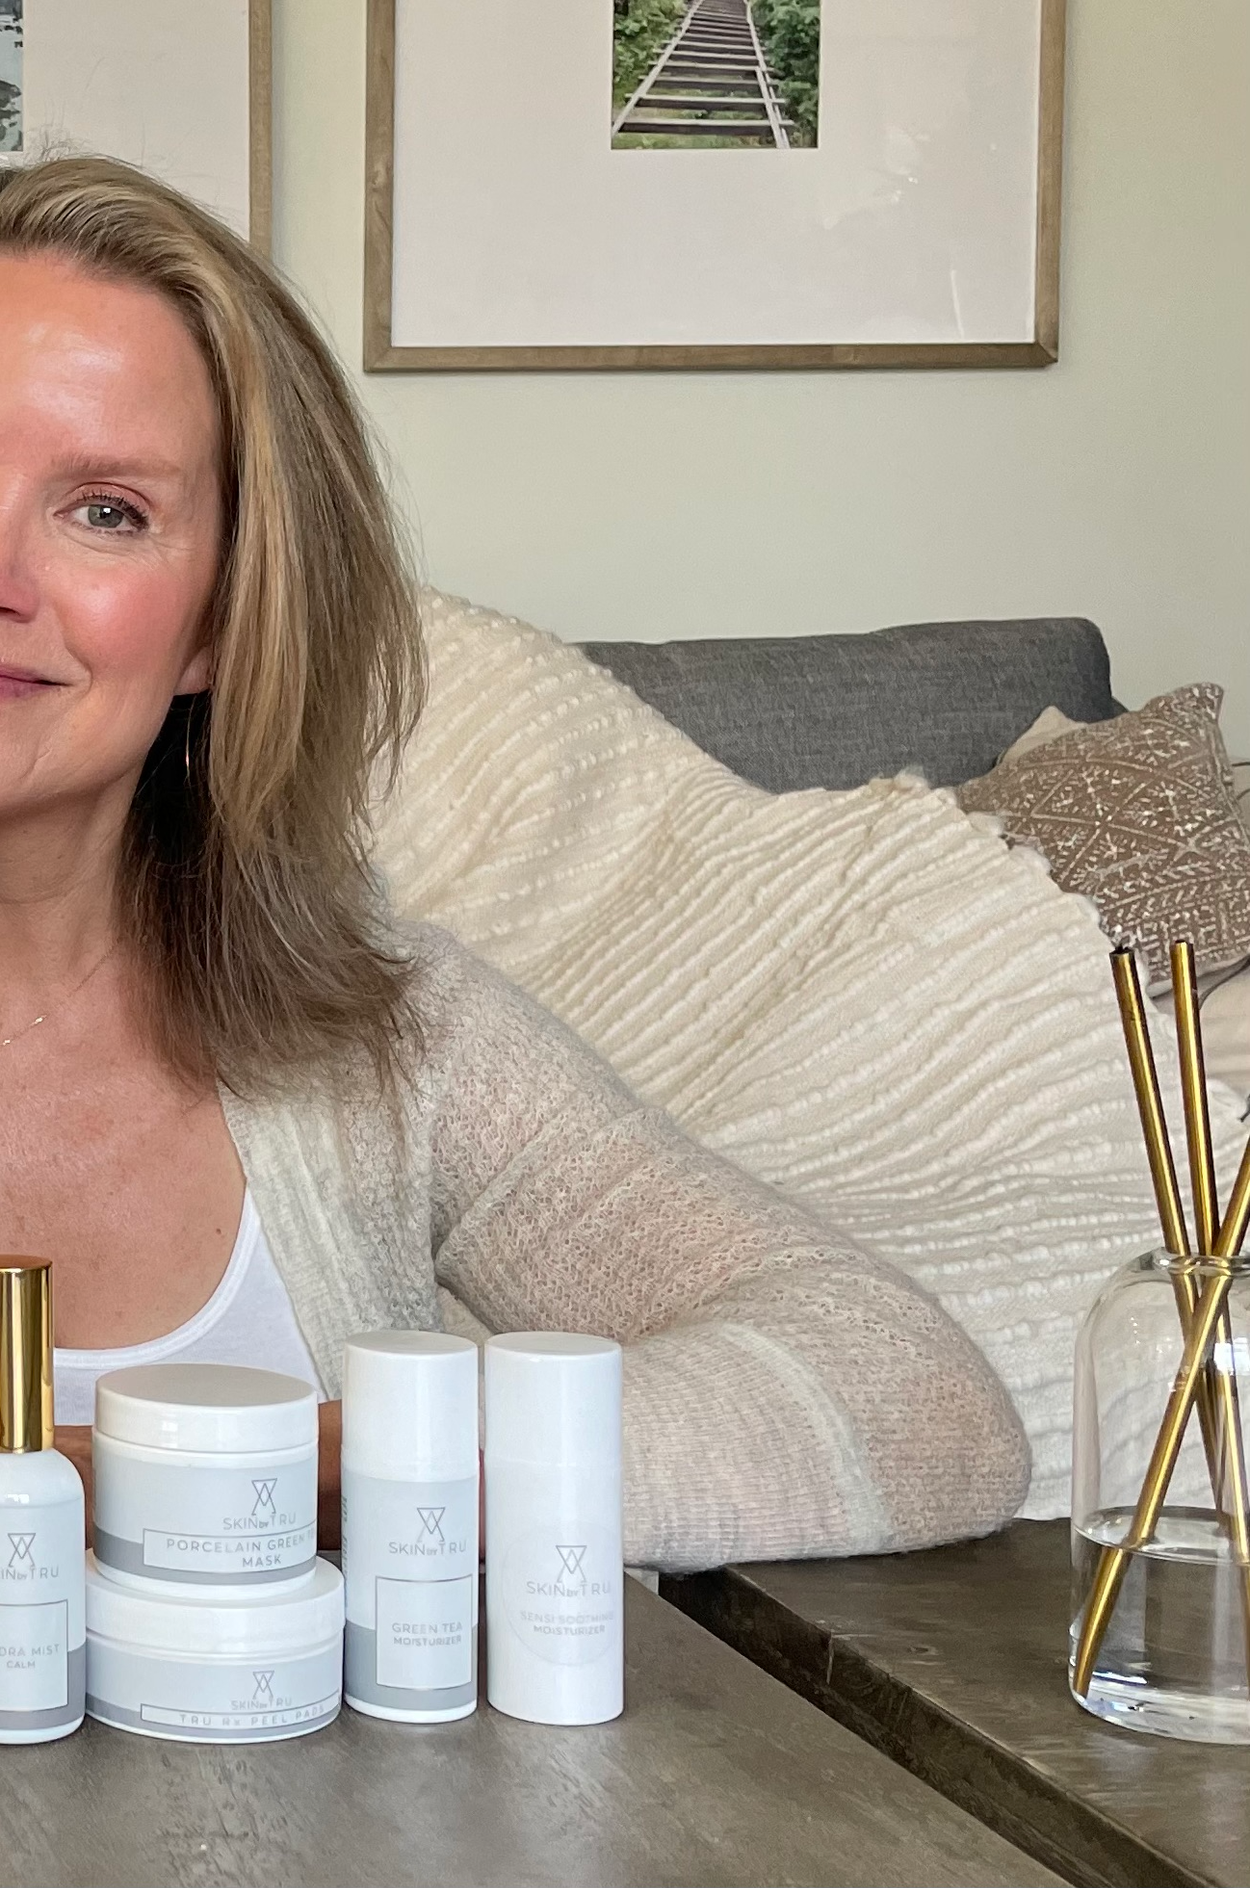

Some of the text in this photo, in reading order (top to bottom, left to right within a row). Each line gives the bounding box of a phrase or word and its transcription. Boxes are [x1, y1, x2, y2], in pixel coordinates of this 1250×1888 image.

[166, 1538, 262, 1554] PORCELAIN
[267, 1533, 305, 1550] GREEN
[242, 1554, 282, 1568] MASK
[391, 1621, 463, 1635] GREEN TEA
[533, 1625, 606, 1636] MOISTURIZER
[393, 1635, 462, 1647] MOISTURIZER
[31, 1643, 60, 1657] MIST
[6, 1661, 36, 1669] CALM
[179, 1714, 212, 1726] TRU
[251, 1713, 288, 1726] PEEL
[295, 1704, 325, 1721] PADS
